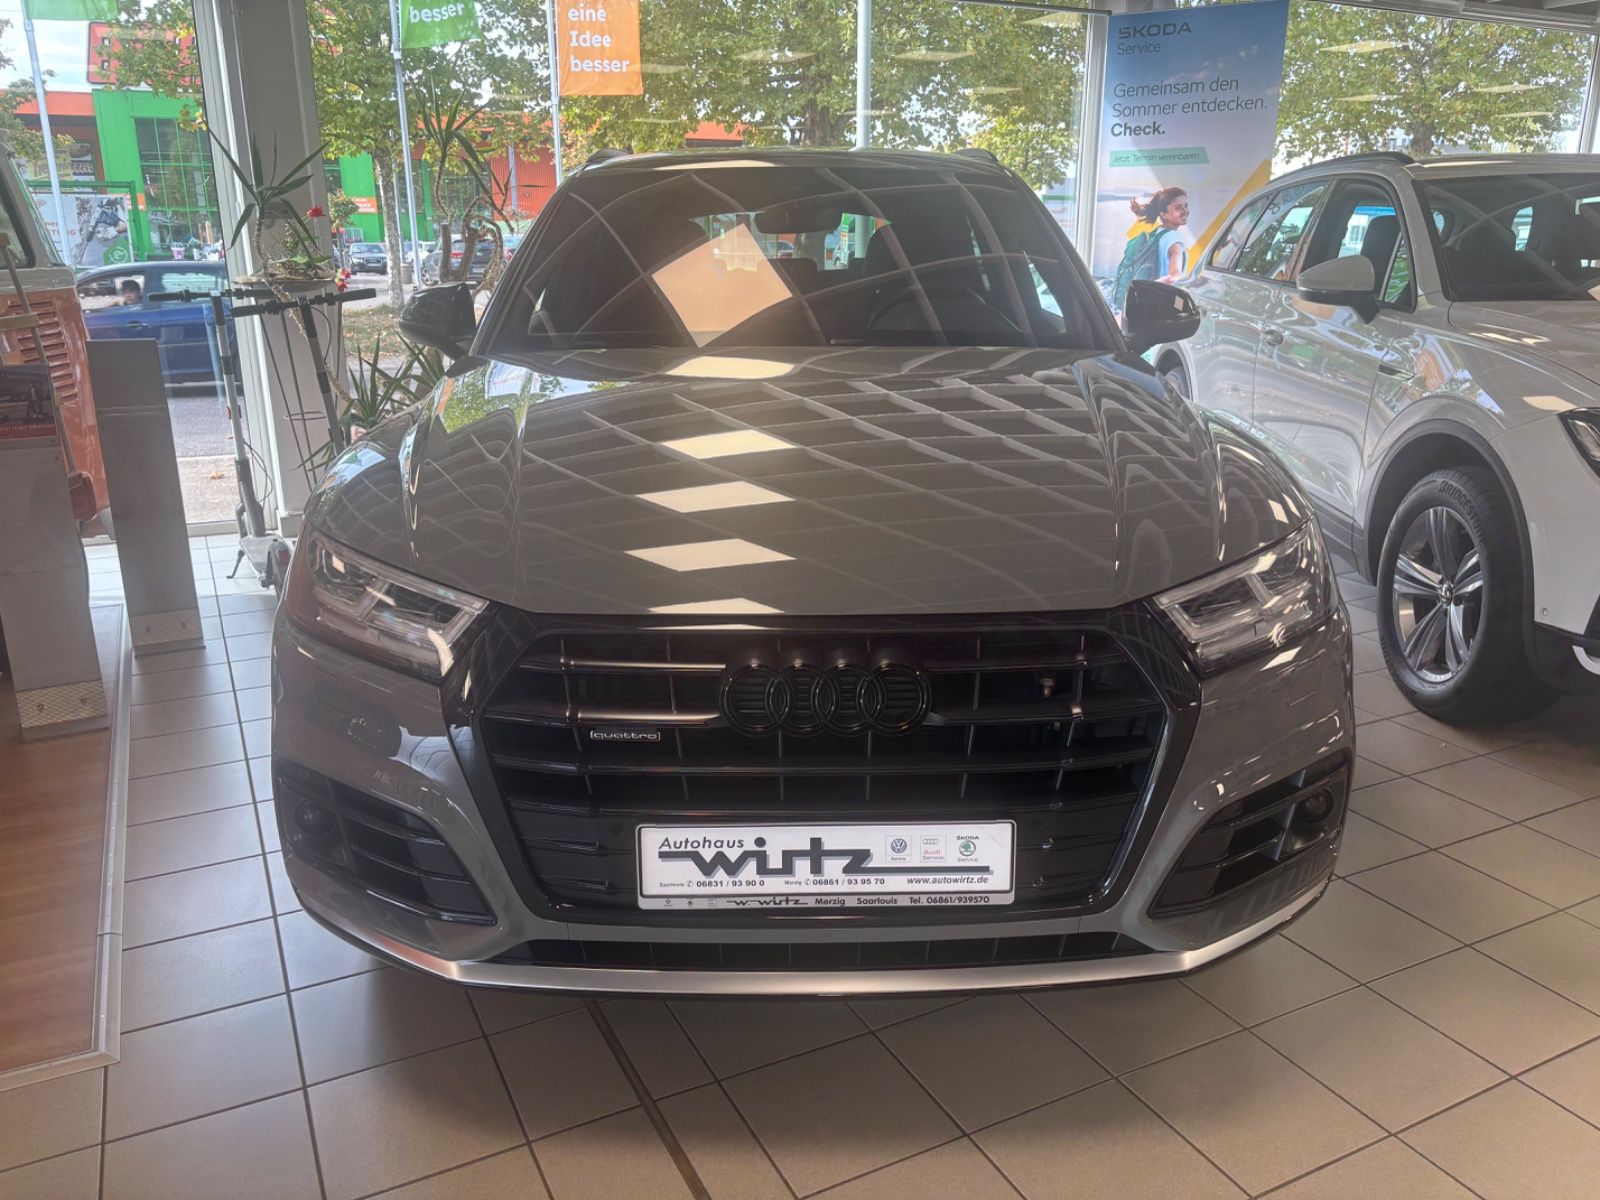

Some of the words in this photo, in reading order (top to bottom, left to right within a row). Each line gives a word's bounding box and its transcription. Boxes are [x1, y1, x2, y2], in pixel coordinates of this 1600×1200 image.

[409, 3, 465, 23] besser
[568, 5, 606, 22] eine
[1118, 21, 1193, 39] SKODA
[569, 30, 612, 48] Idee
[1116, 41, 1161, 56] Service
[569, 55, 631, 73] besser
[1113, 80, 1205, 98] Gemeinsam
[1209, 76, 1239, 92] den
[1112, 101, 1178, 118] Sommer
[1181, 95, 1268, 114] entdecken.
[1110, 121, 1166, 137] Check.
[1113, 154, 1130, 163] Jetzt
[1133, 153, 1157, 161] Termin
[593, 732, 658, 740] quattro
[658, 836, 745, 850] Autohaus
[658, 836, 990, 877] wirtz
[696, 880, 723, 888] 06831
[759, 879, 765, 887] 0
[907, 876, 989, 885] www.autowirtz.de
[814, 897, 846, 906] Merzig
[856, 896, 898, 905] Saarlouis
[909, 896, 924, 905] Tel.
[926, 895, 990, 904] 06861/939570
